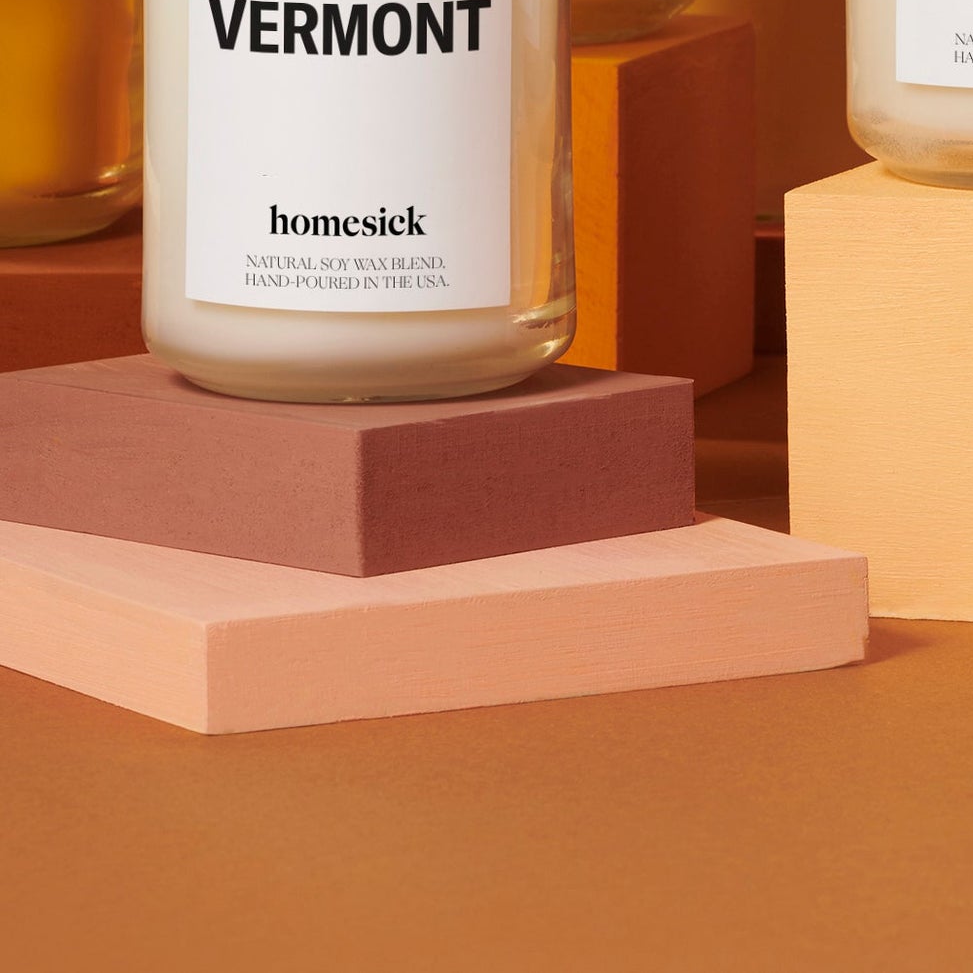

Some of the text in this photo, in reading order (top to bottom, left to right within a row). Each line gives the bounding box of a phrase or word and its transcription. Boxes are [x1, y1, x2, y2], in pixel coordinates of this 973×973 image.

[268, 203, 428, 237] homesick
[246, 254, 446, 271] NATURAL SOY WAX BLEND.
[245, 272, 450, 289] HAND-POURED IN THE USA.
